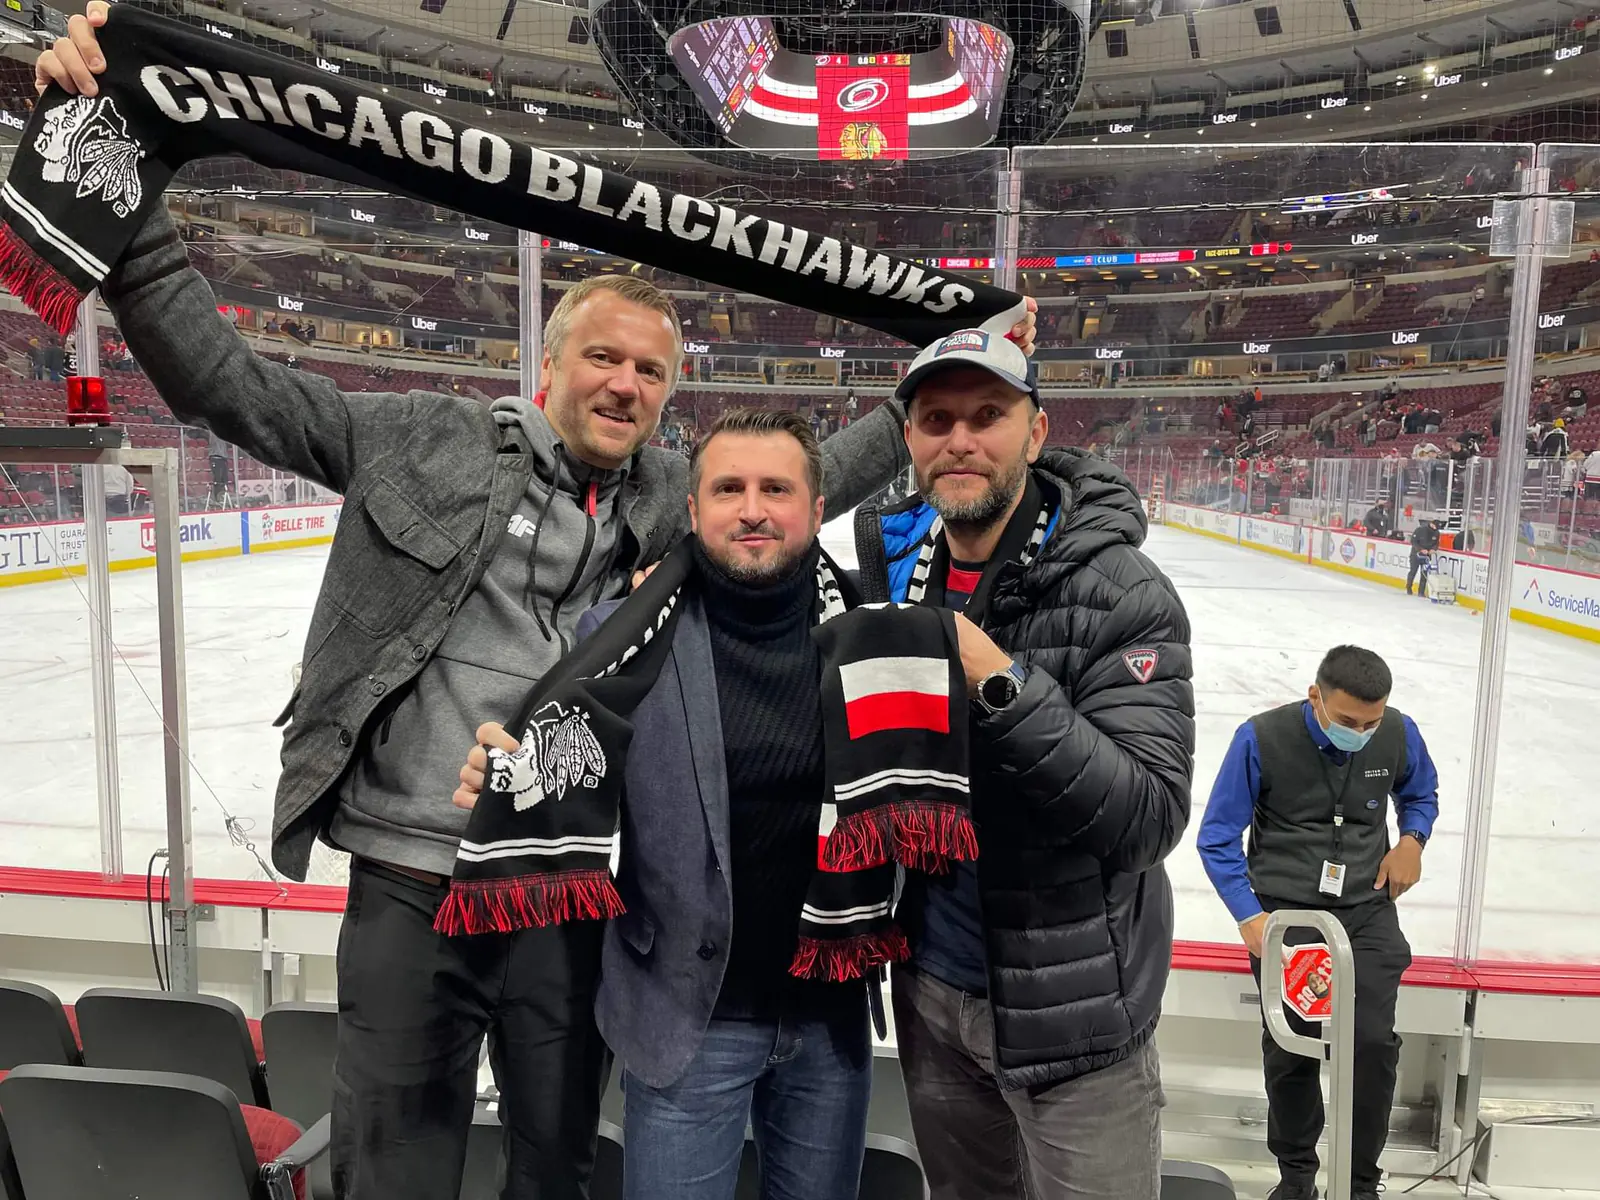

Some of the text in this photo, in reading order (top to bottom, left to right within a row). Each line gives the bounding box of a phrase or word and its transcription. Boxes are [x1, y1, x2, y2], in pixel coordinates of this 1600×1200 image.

[1554, 45, 1584, 61] Uber
[316, 56, 341, 74] Uber
[1433, 72, 1462, 88] Uber
[423, 82, 448, 97] Uber
[523, 103, 548, 116] Uber
[1320, 97, 1348, 109] Uber
[622, 117, 645, 130] Uber
[1212, 112, 1238, 125] Uber
[1109, 123, 1134, 134] Uber
[139, 64, 975, 314] CHICAGO BLACKHAWKS
[350, 208, 376, 223] Uber
[1476, 215, 1504, 229] Uber
[464, 227, 490, 241] Uber
[1351, 233, 1379, 246] Uber
[1097, 256, 1118, 264] CLUB
[278, 295, 304, 312] Uber
[411, 316, 438, 331] Uber
[1538, 313, 1566, 329] Uber
[1392, 331, 1420, 345] Uber
[683, 341, 710, 354] Uber
[820, 347, 846, 358] Uber
[1095, 347, 1124, 359] Uber
[1243, 342, 1271, 354] Uber
[180, 517, 212, 543] ank
[274, 516, 325, 533] BELLE TIRE
[61, 551, 80, 561] LIFE
